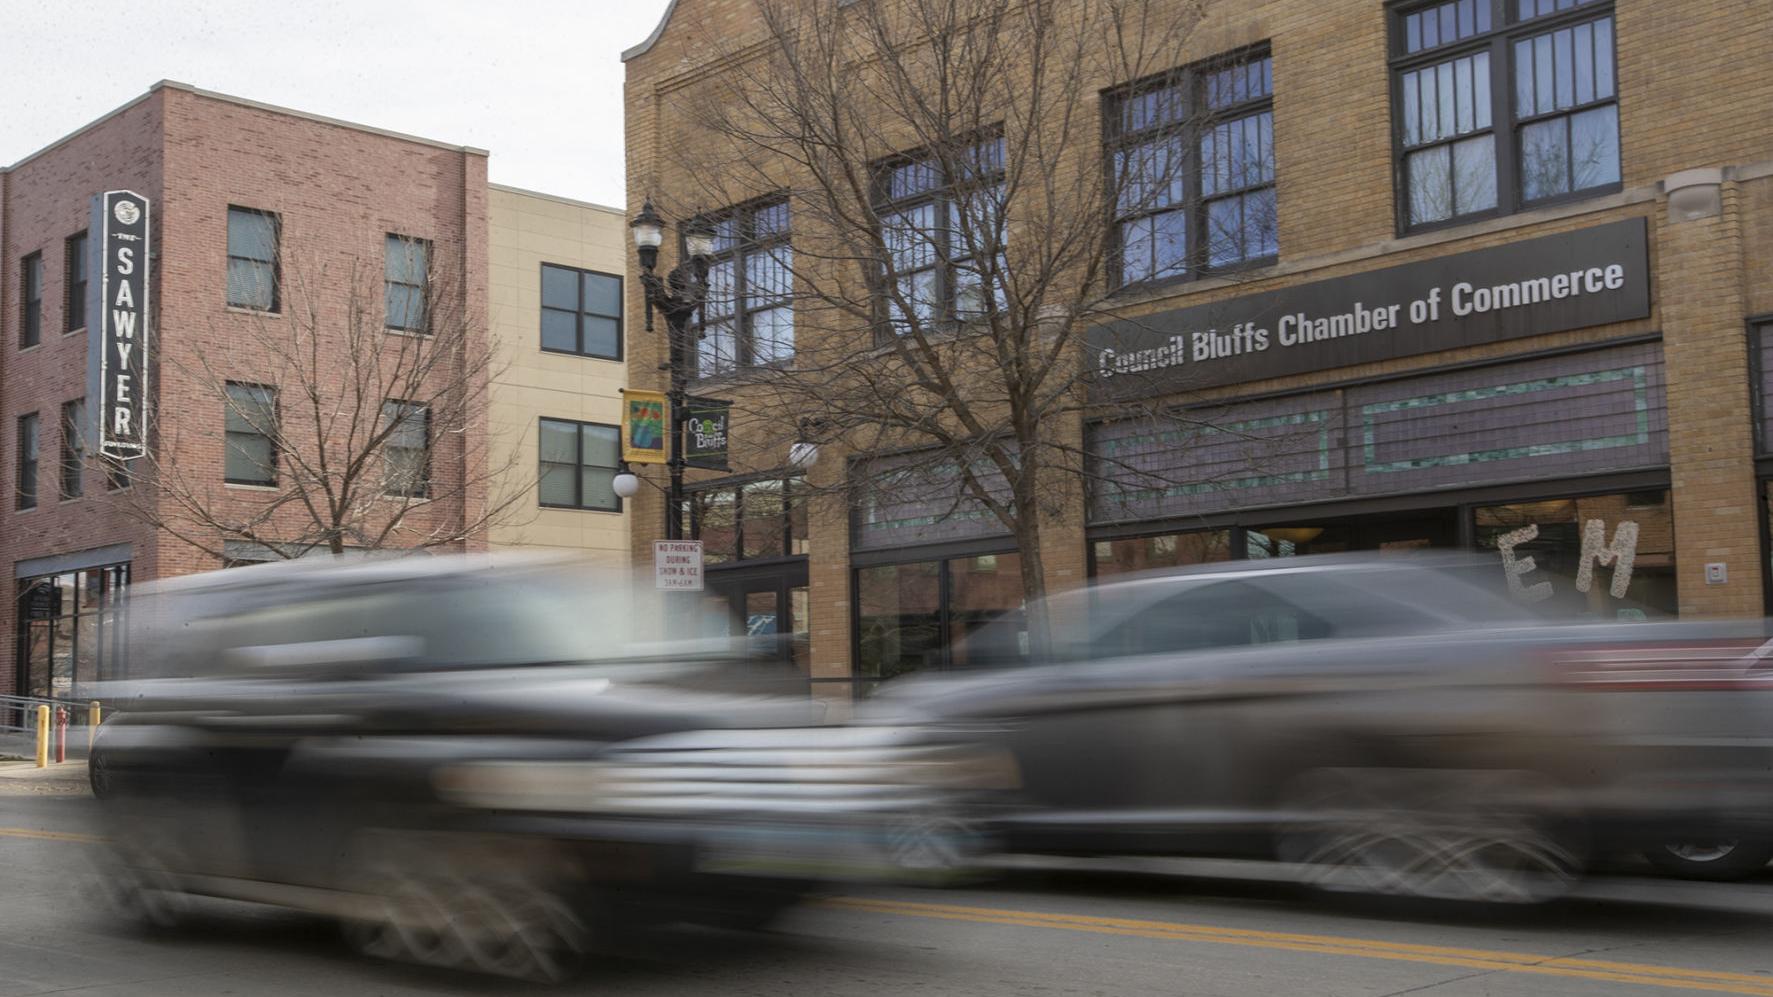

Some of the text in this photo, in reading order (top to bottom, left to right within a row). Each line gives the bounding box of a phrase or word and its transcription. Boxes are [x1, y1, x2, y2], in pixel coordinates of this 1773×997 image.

[1099, 263, 1625, 378] Council Bluffs Chamber of Commerce
[112, 247, 137, 435] SAWYER
[696, 431, 727, 449] Bluffs
[658, 543, 699, 553] NO PARKING
[666, 555, 691, 564] DURING
